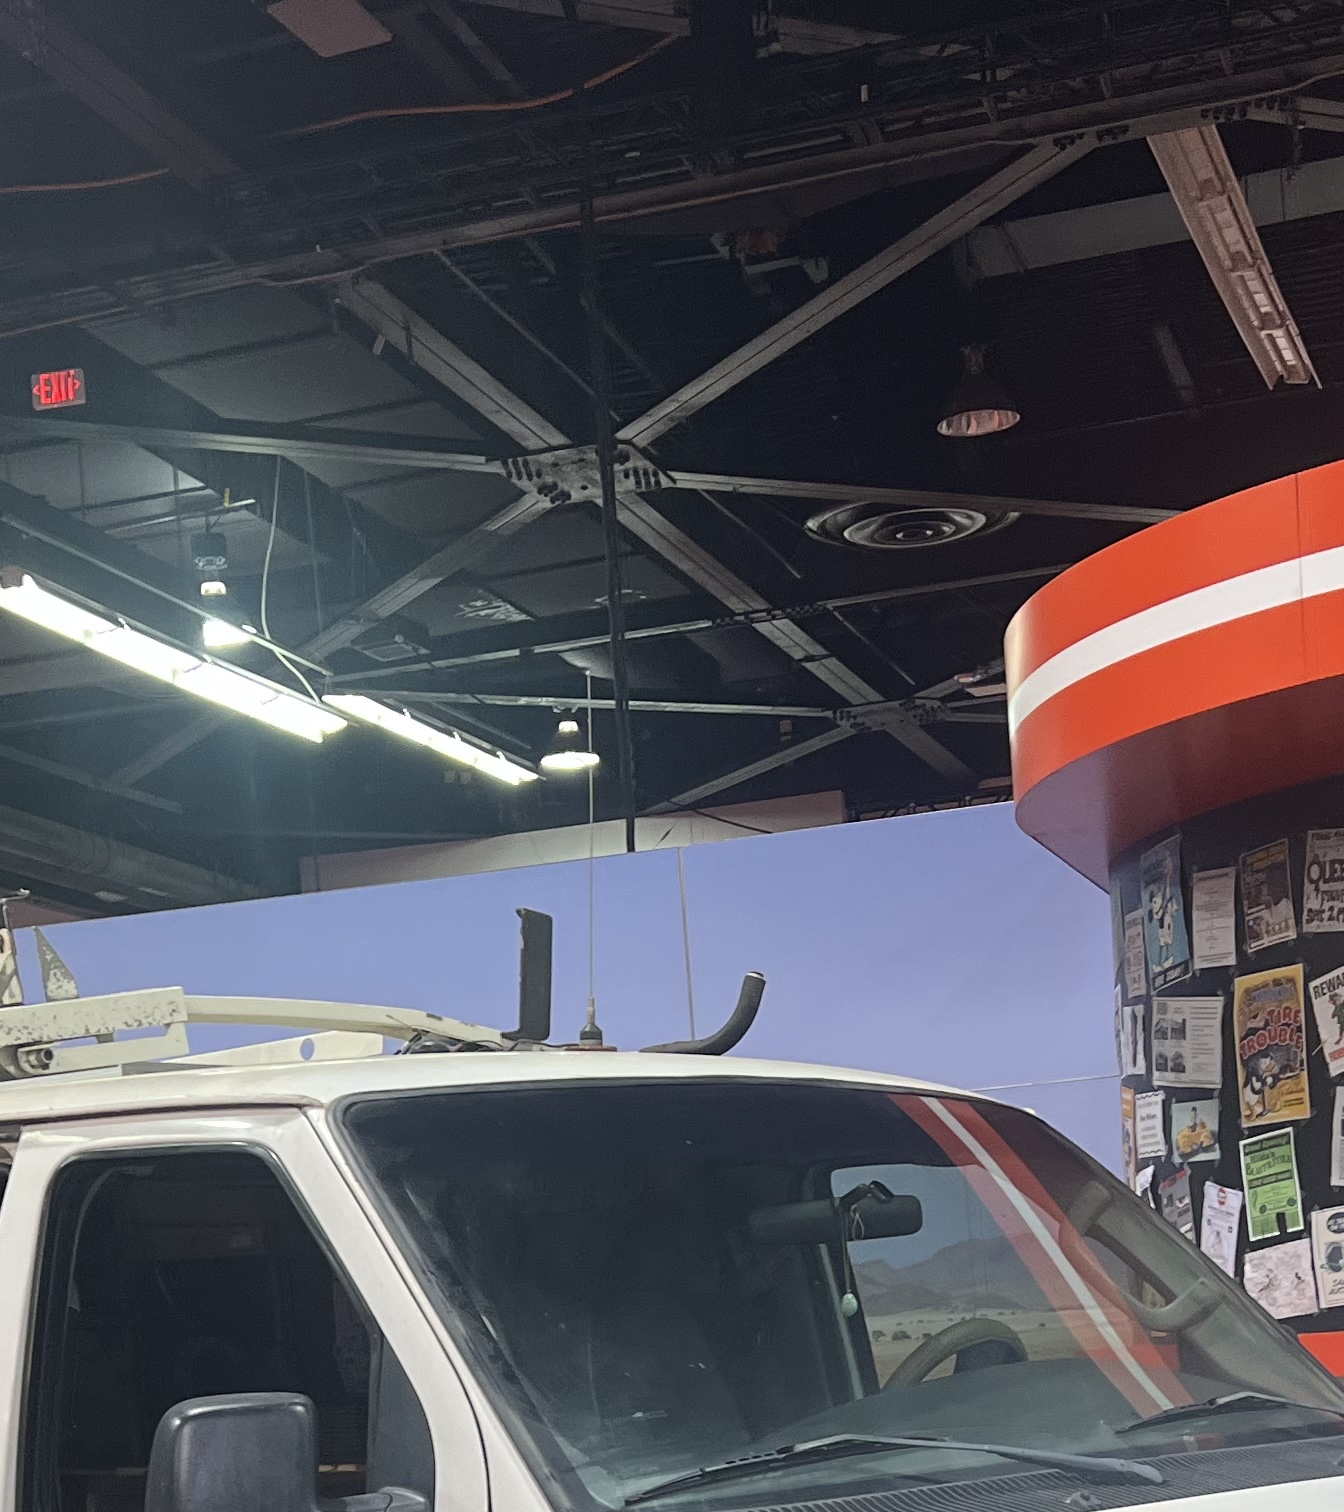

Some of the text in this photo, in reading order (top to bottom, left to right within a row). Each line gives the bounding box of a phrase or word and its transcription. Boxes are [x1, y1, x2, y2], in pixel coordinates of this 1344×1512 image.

[40, 370, 75, 404] EXIT
[1266, 1006, 1302, 1026] TIRE
[1239, 1025, 1303, 1060] TROUBLE
